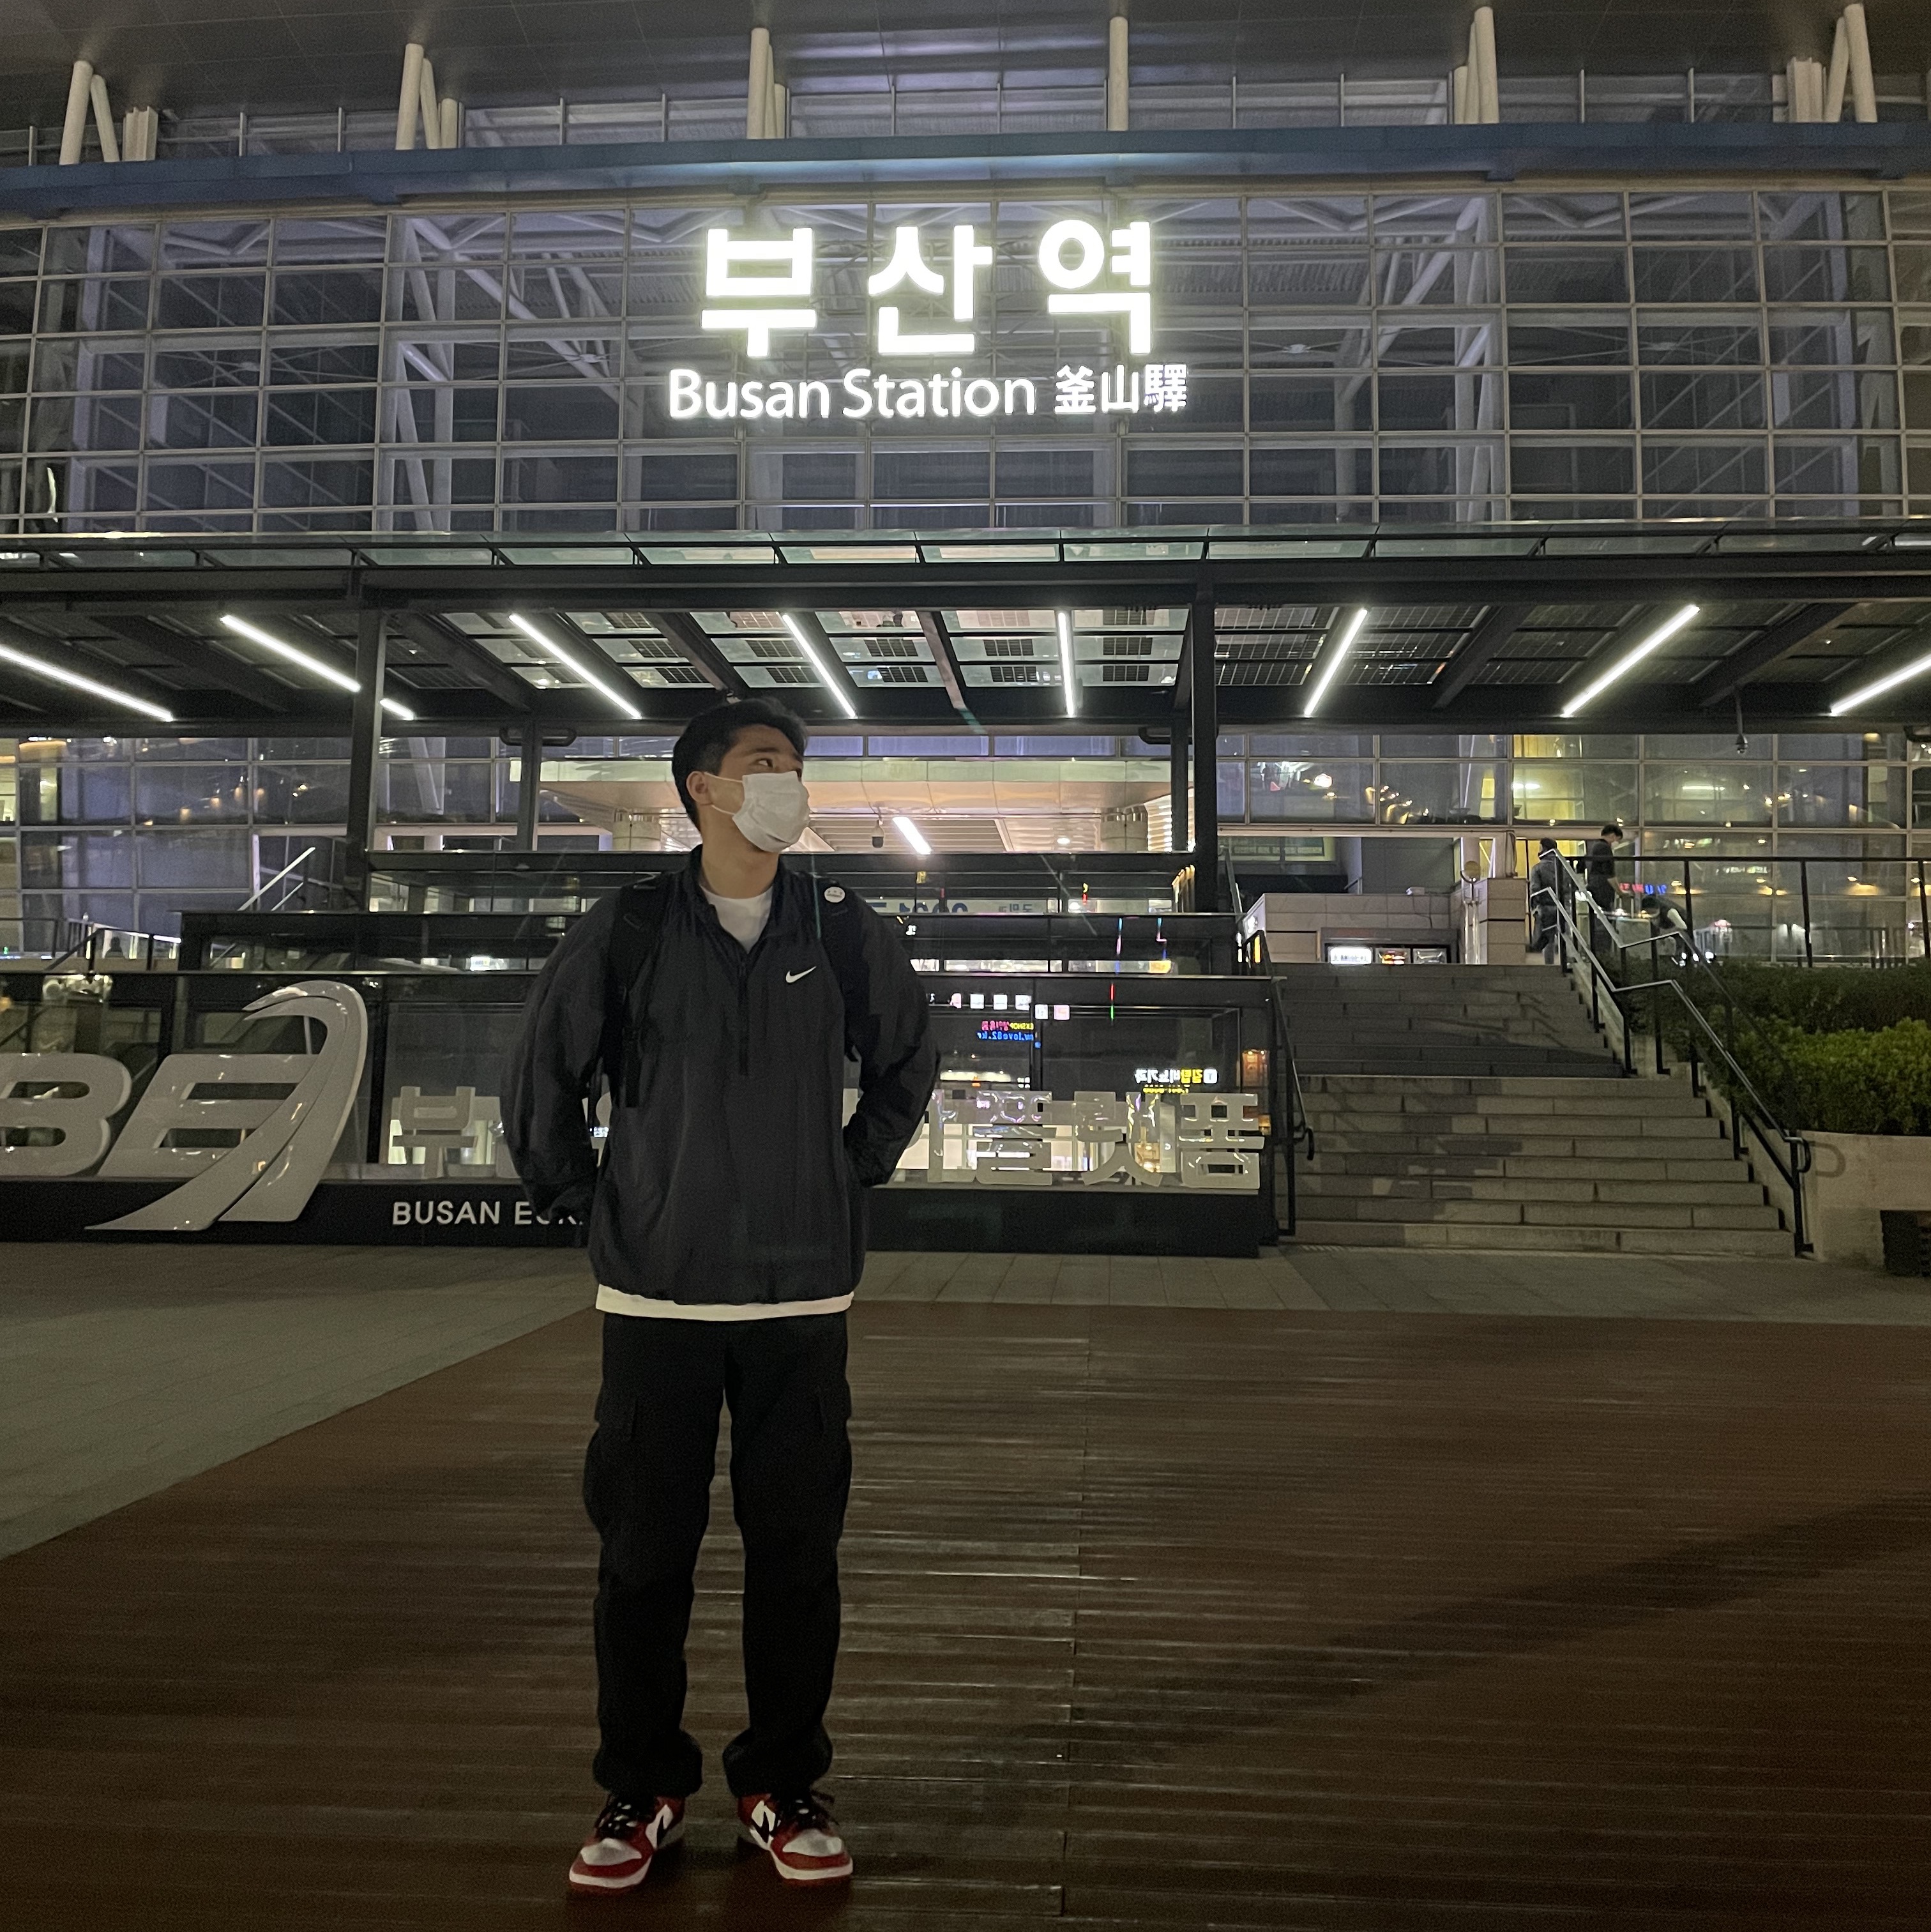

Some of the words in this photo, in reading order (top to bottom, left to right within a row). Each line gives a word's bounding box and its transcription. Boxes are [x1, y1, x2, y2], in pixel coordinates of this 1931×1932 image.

[700, 219, 1151, 358] 부산역
[669, 369, 830, 419] Busan
[842, 368, 1037, 418] Station
[1054, 363, 1188, 415] 釜山驛
[392, 1200, 501, 1226] BUSAN
